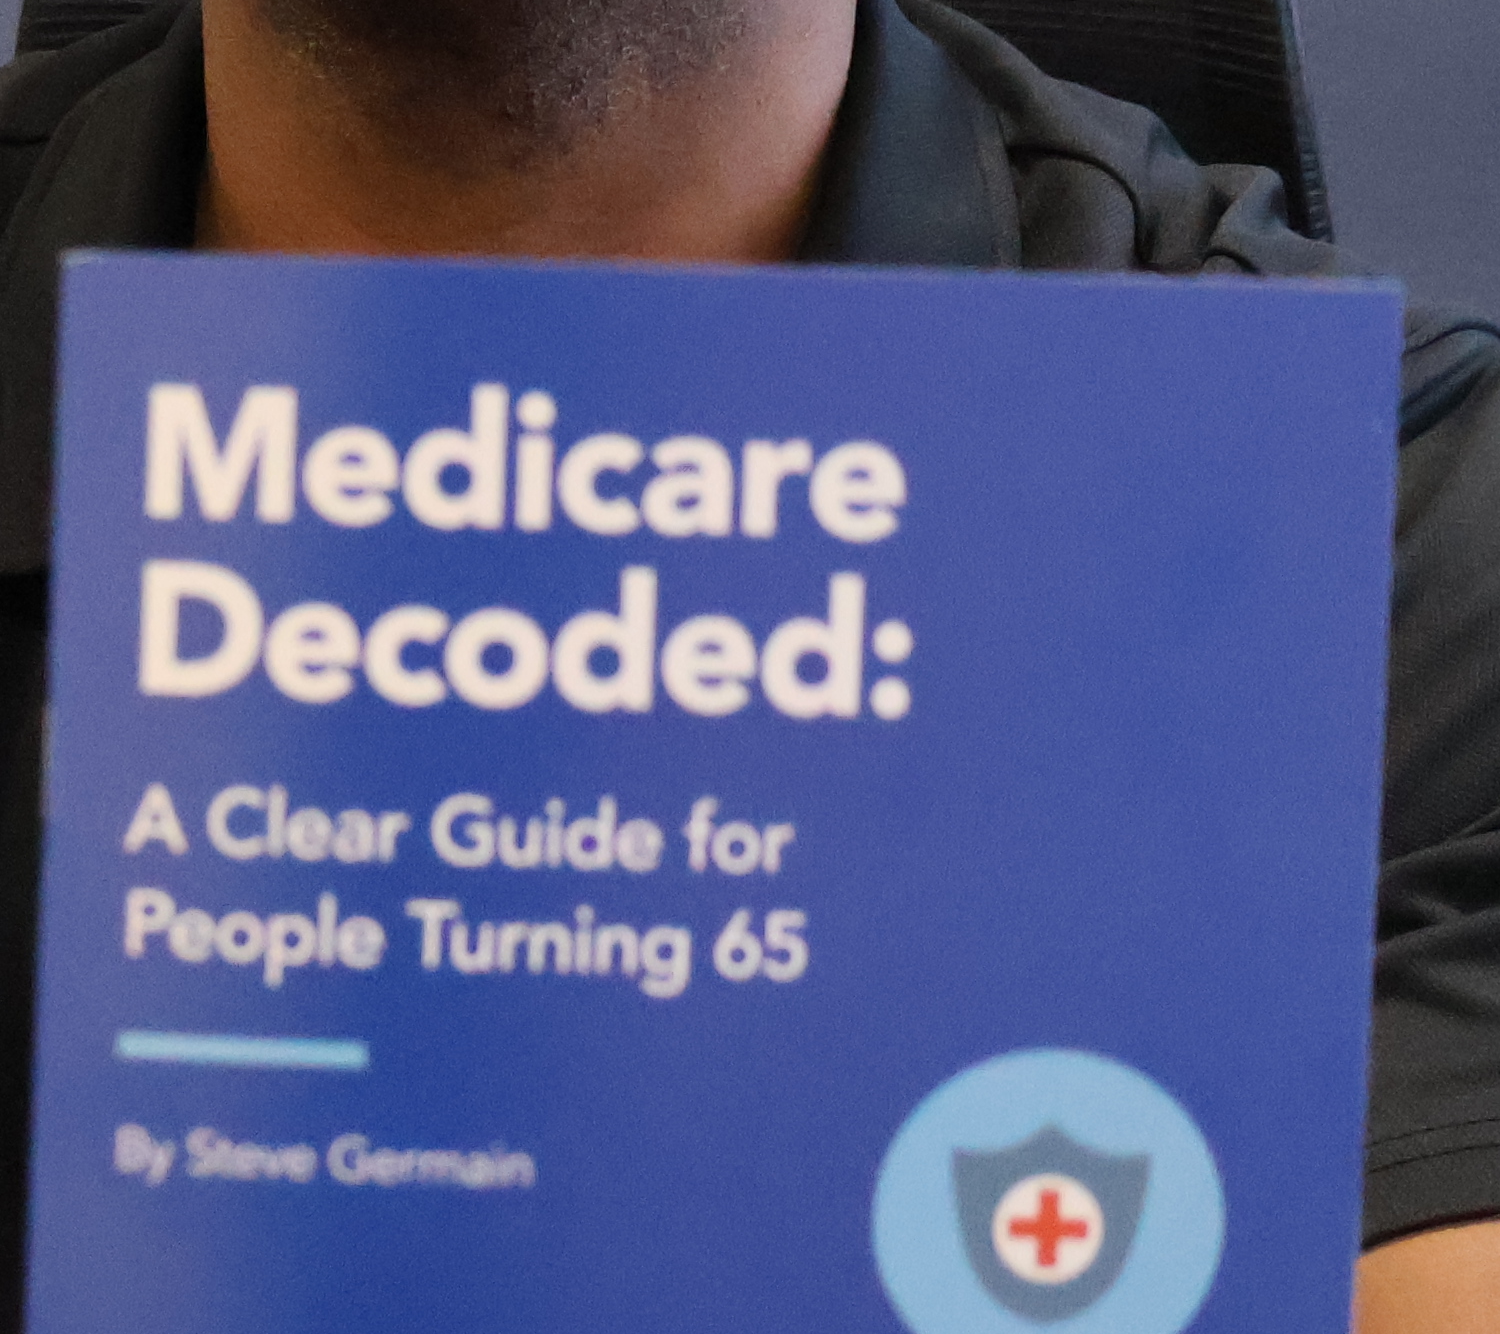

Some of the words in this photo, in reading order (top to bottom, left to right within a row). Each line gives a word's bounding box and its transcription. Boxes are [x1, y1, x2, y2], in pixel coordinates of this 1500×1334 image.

[144, 382, 907, 543] Medicare
[137, 558, 913, 720] Decoded:
[122, 783, 189, 855] A
[205, 783, 411, 864] Clear
[431, 792, 665, 874] Guide
[682, 796, 797, 876] for
[122, 885, 386, 988] People
[405, 897, 693, 1000] Turning
[712, 909, 810, 984] 65
[112, 1122, 176, 1187] By
[185, 1125, 318, 1183] Steve
[325, 1131, 537, 1191] Germain
